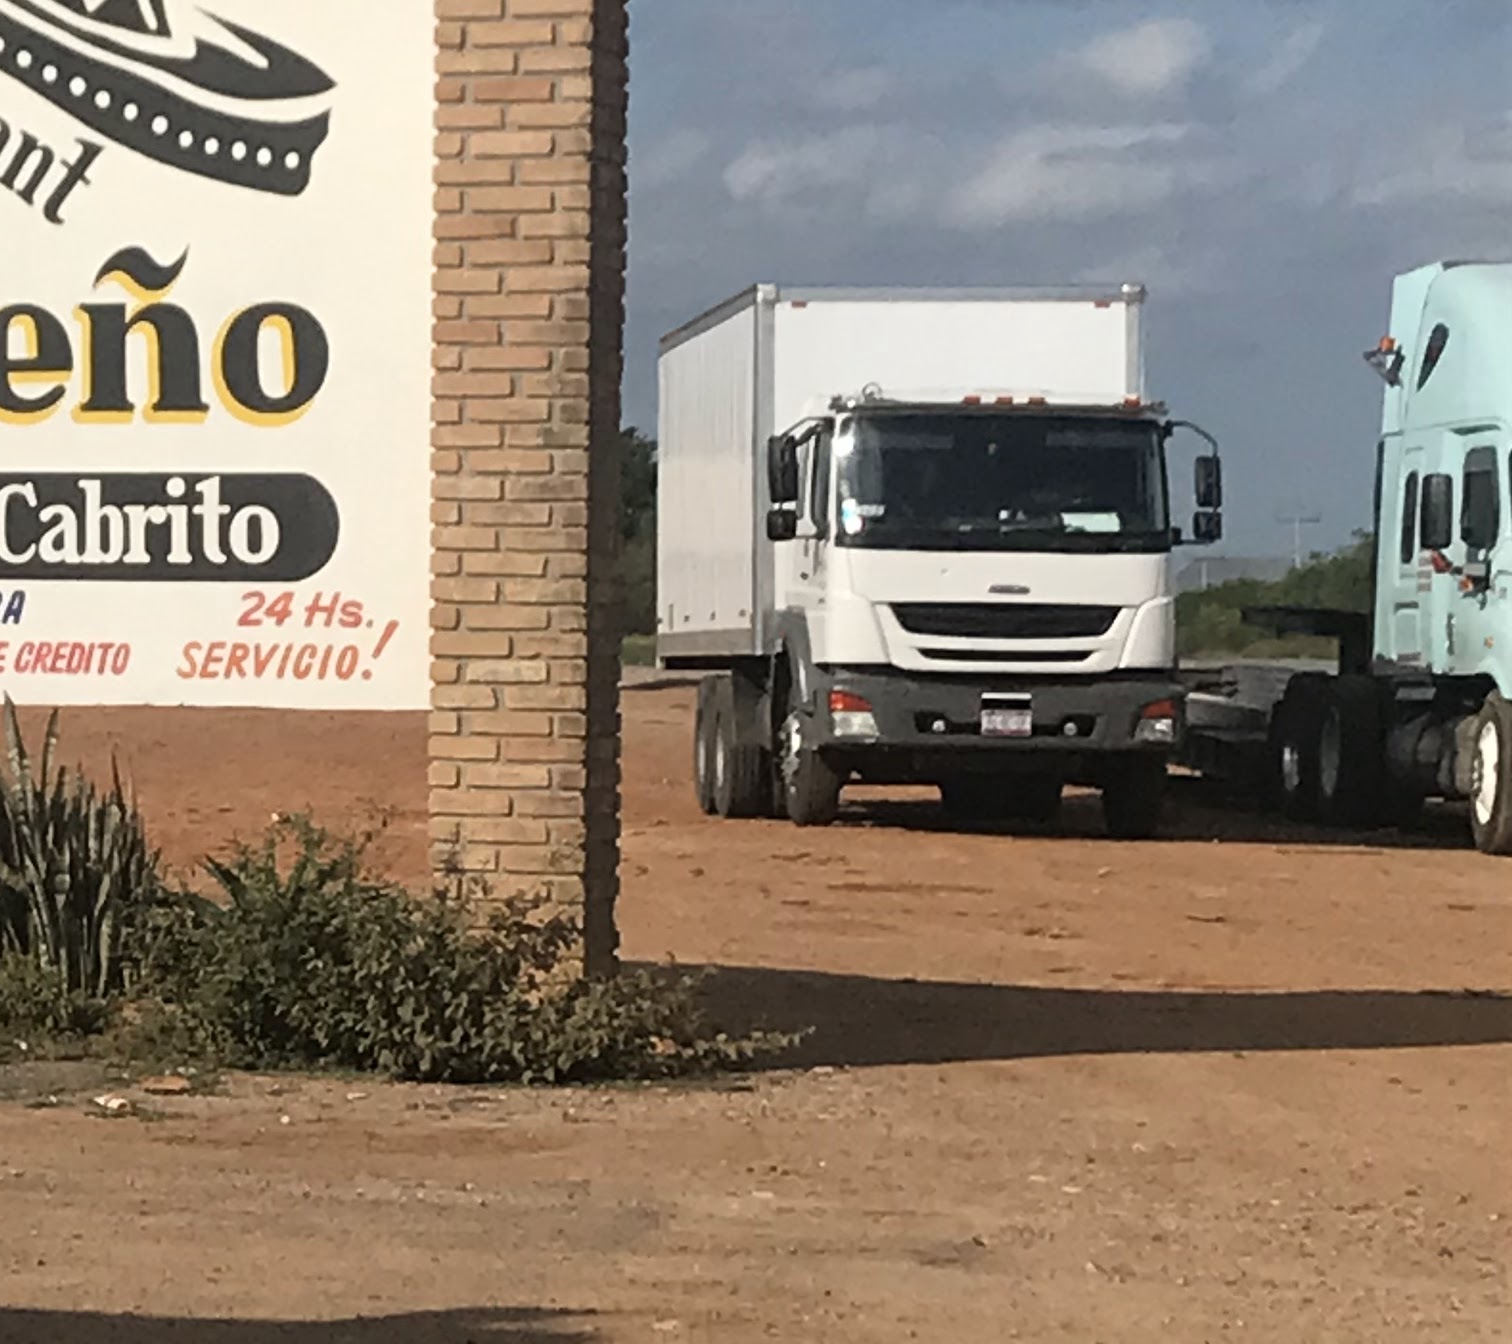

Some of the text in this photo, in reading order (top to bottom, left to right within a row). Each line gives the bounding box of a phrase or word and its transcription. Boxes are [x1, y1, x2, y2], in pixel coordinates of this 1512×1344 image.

[237, 590, 374, 628] 24 Hs.
[14, 641, 131, 676] CREDITO
